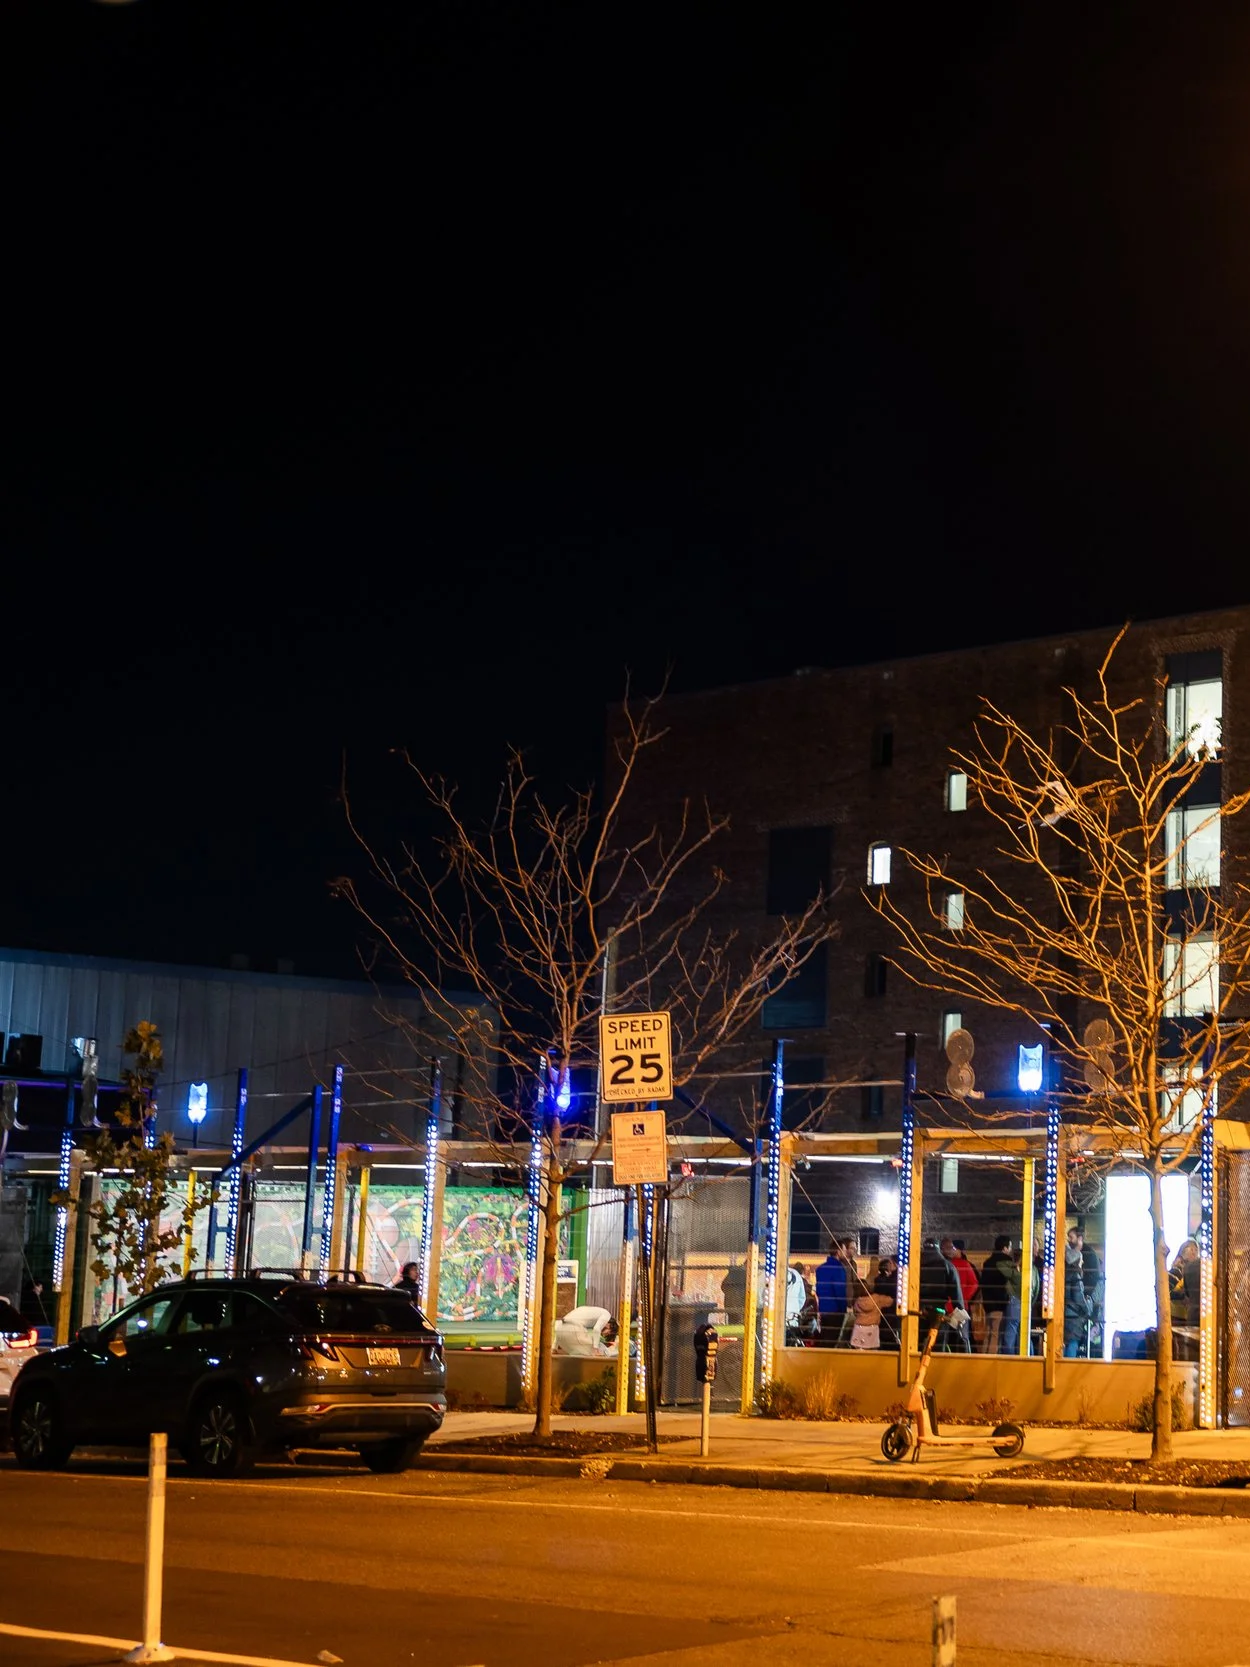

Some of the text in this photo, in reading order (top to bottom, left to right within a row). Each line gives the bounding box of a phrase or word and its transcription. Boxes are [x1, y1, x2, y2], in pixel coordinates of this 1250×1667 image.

[608, 1019, 663, 1034] SPEED
[614, 1036, 656, 1051] LIMIT
[610, 1053, 663, 1085] 25
